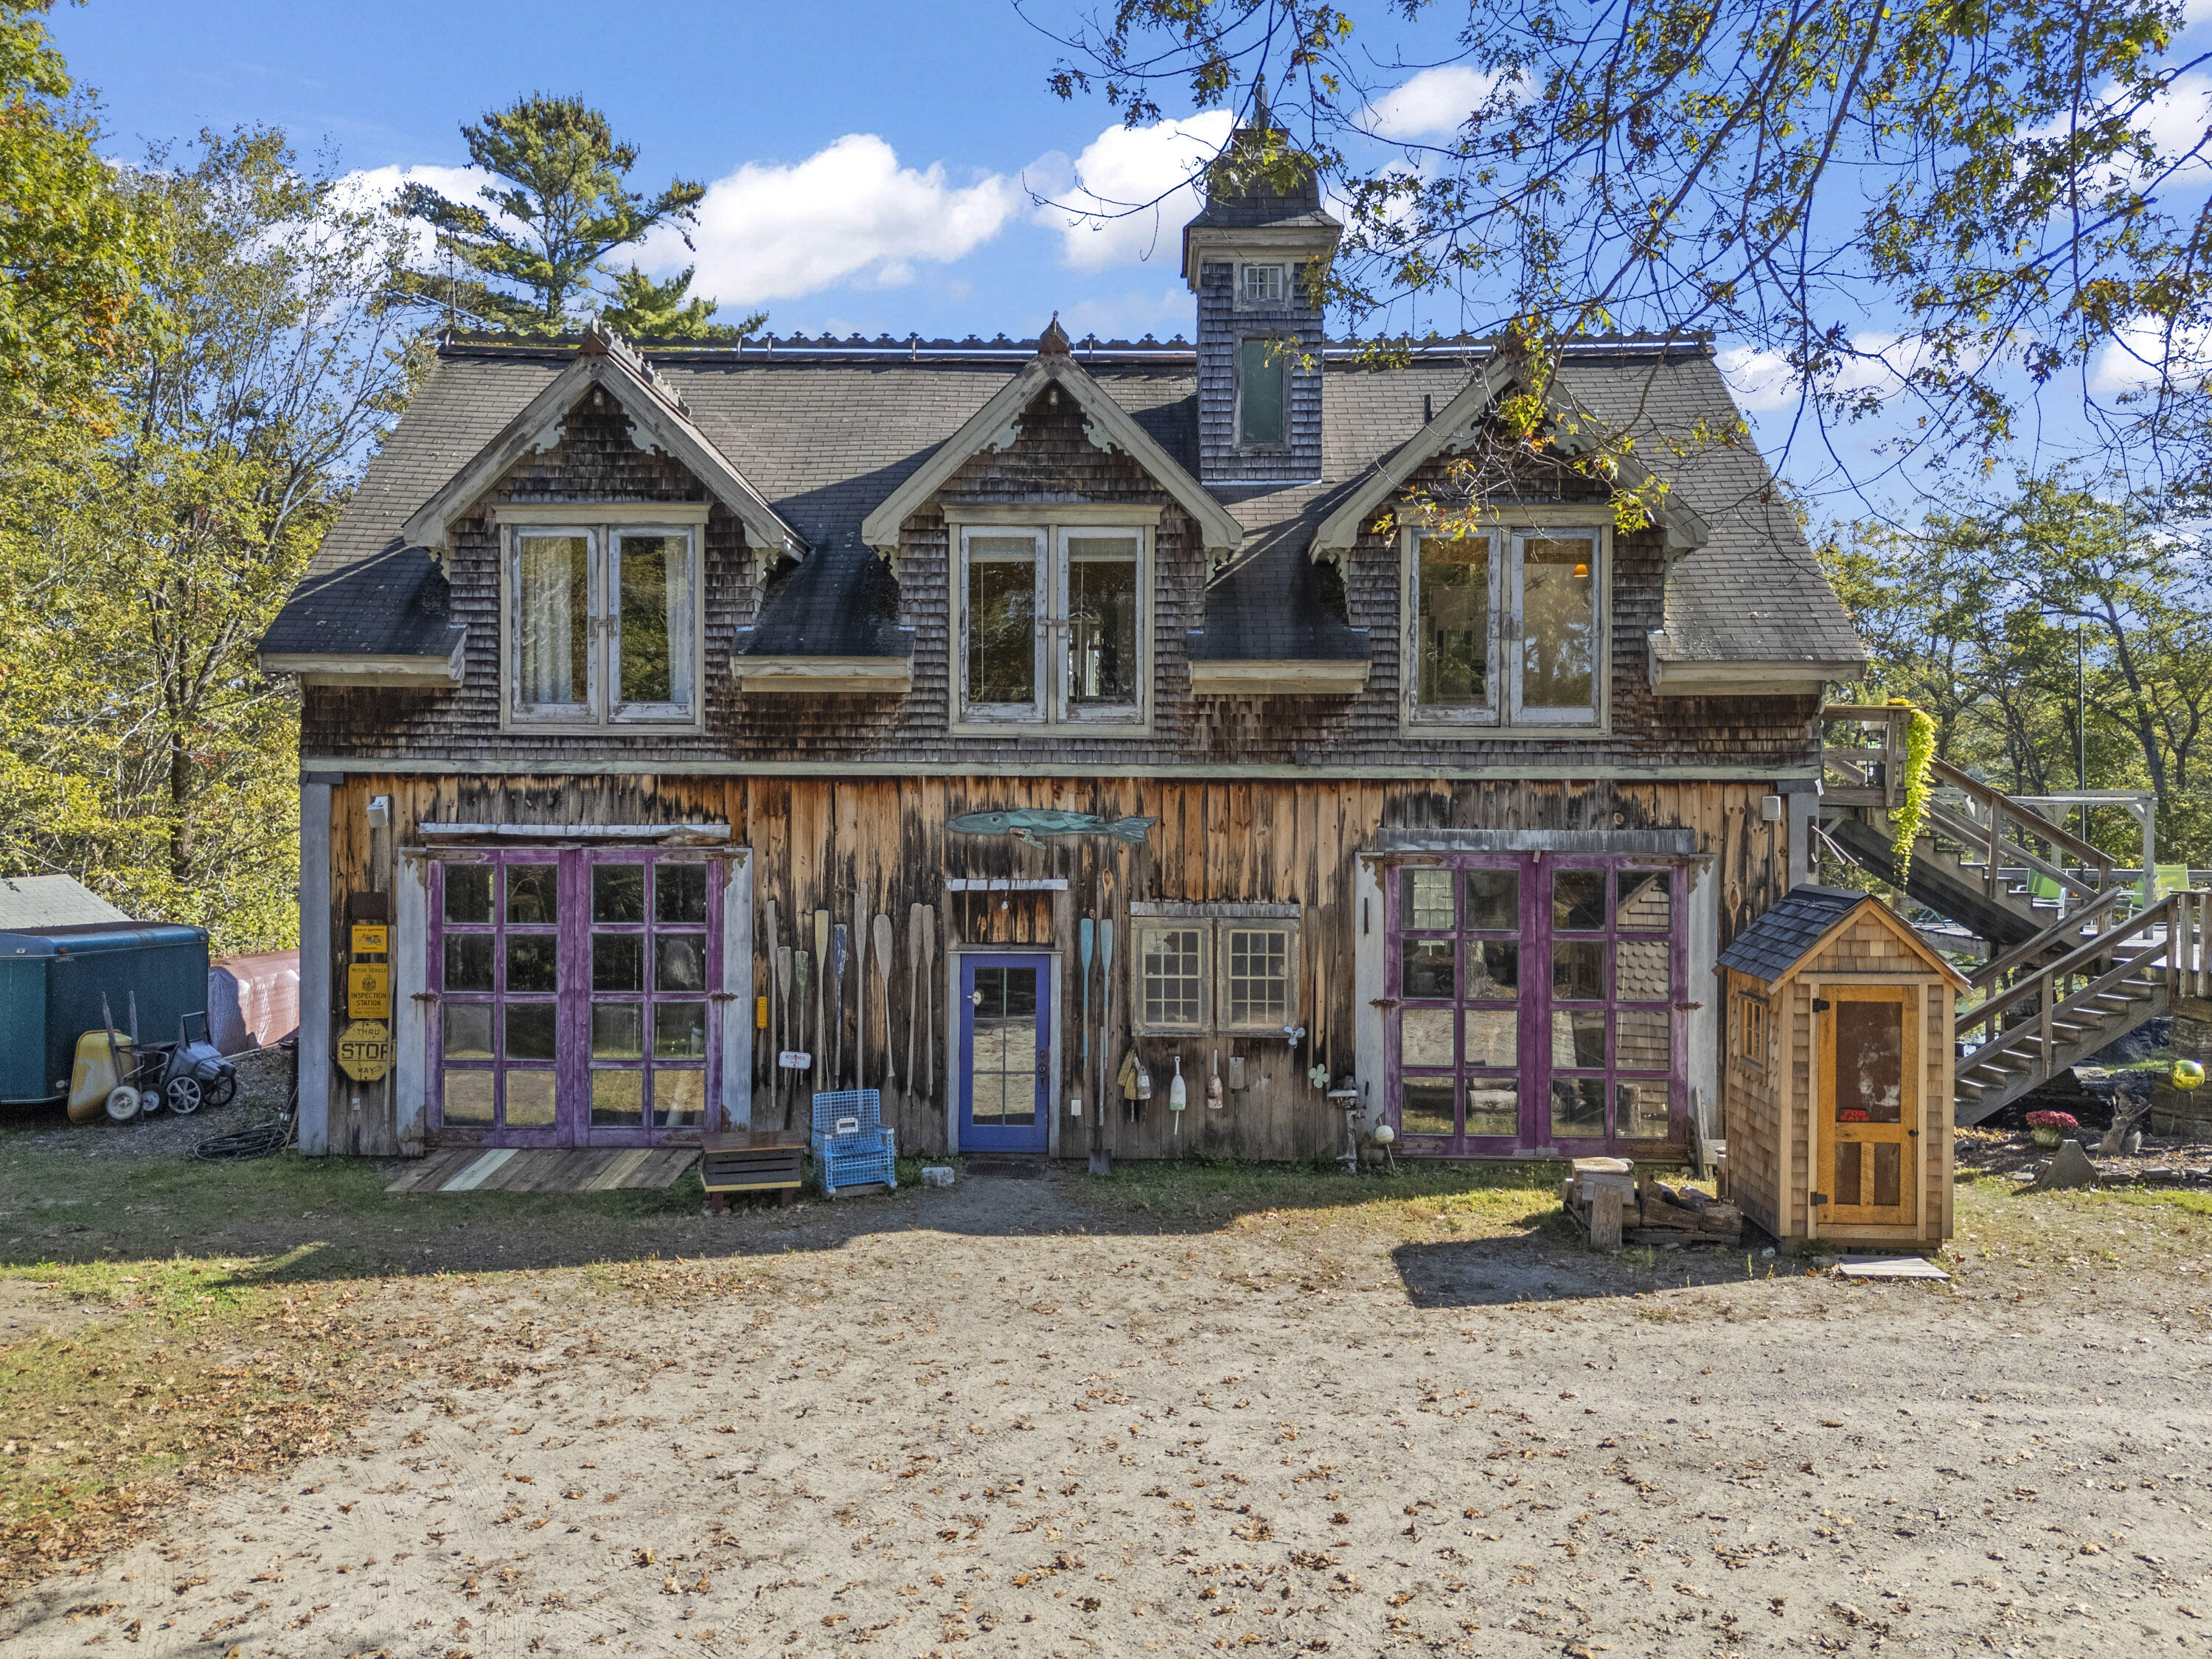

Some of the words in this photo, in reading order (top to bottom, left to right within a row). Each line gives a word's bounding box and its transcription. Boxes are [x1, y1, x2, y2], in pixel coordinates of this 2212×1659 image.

[341, 1043, 394, 1060] STOP
[358, 1067, 375, 1075] WAY
[1844, 1109, 1866, 1117] FOR
